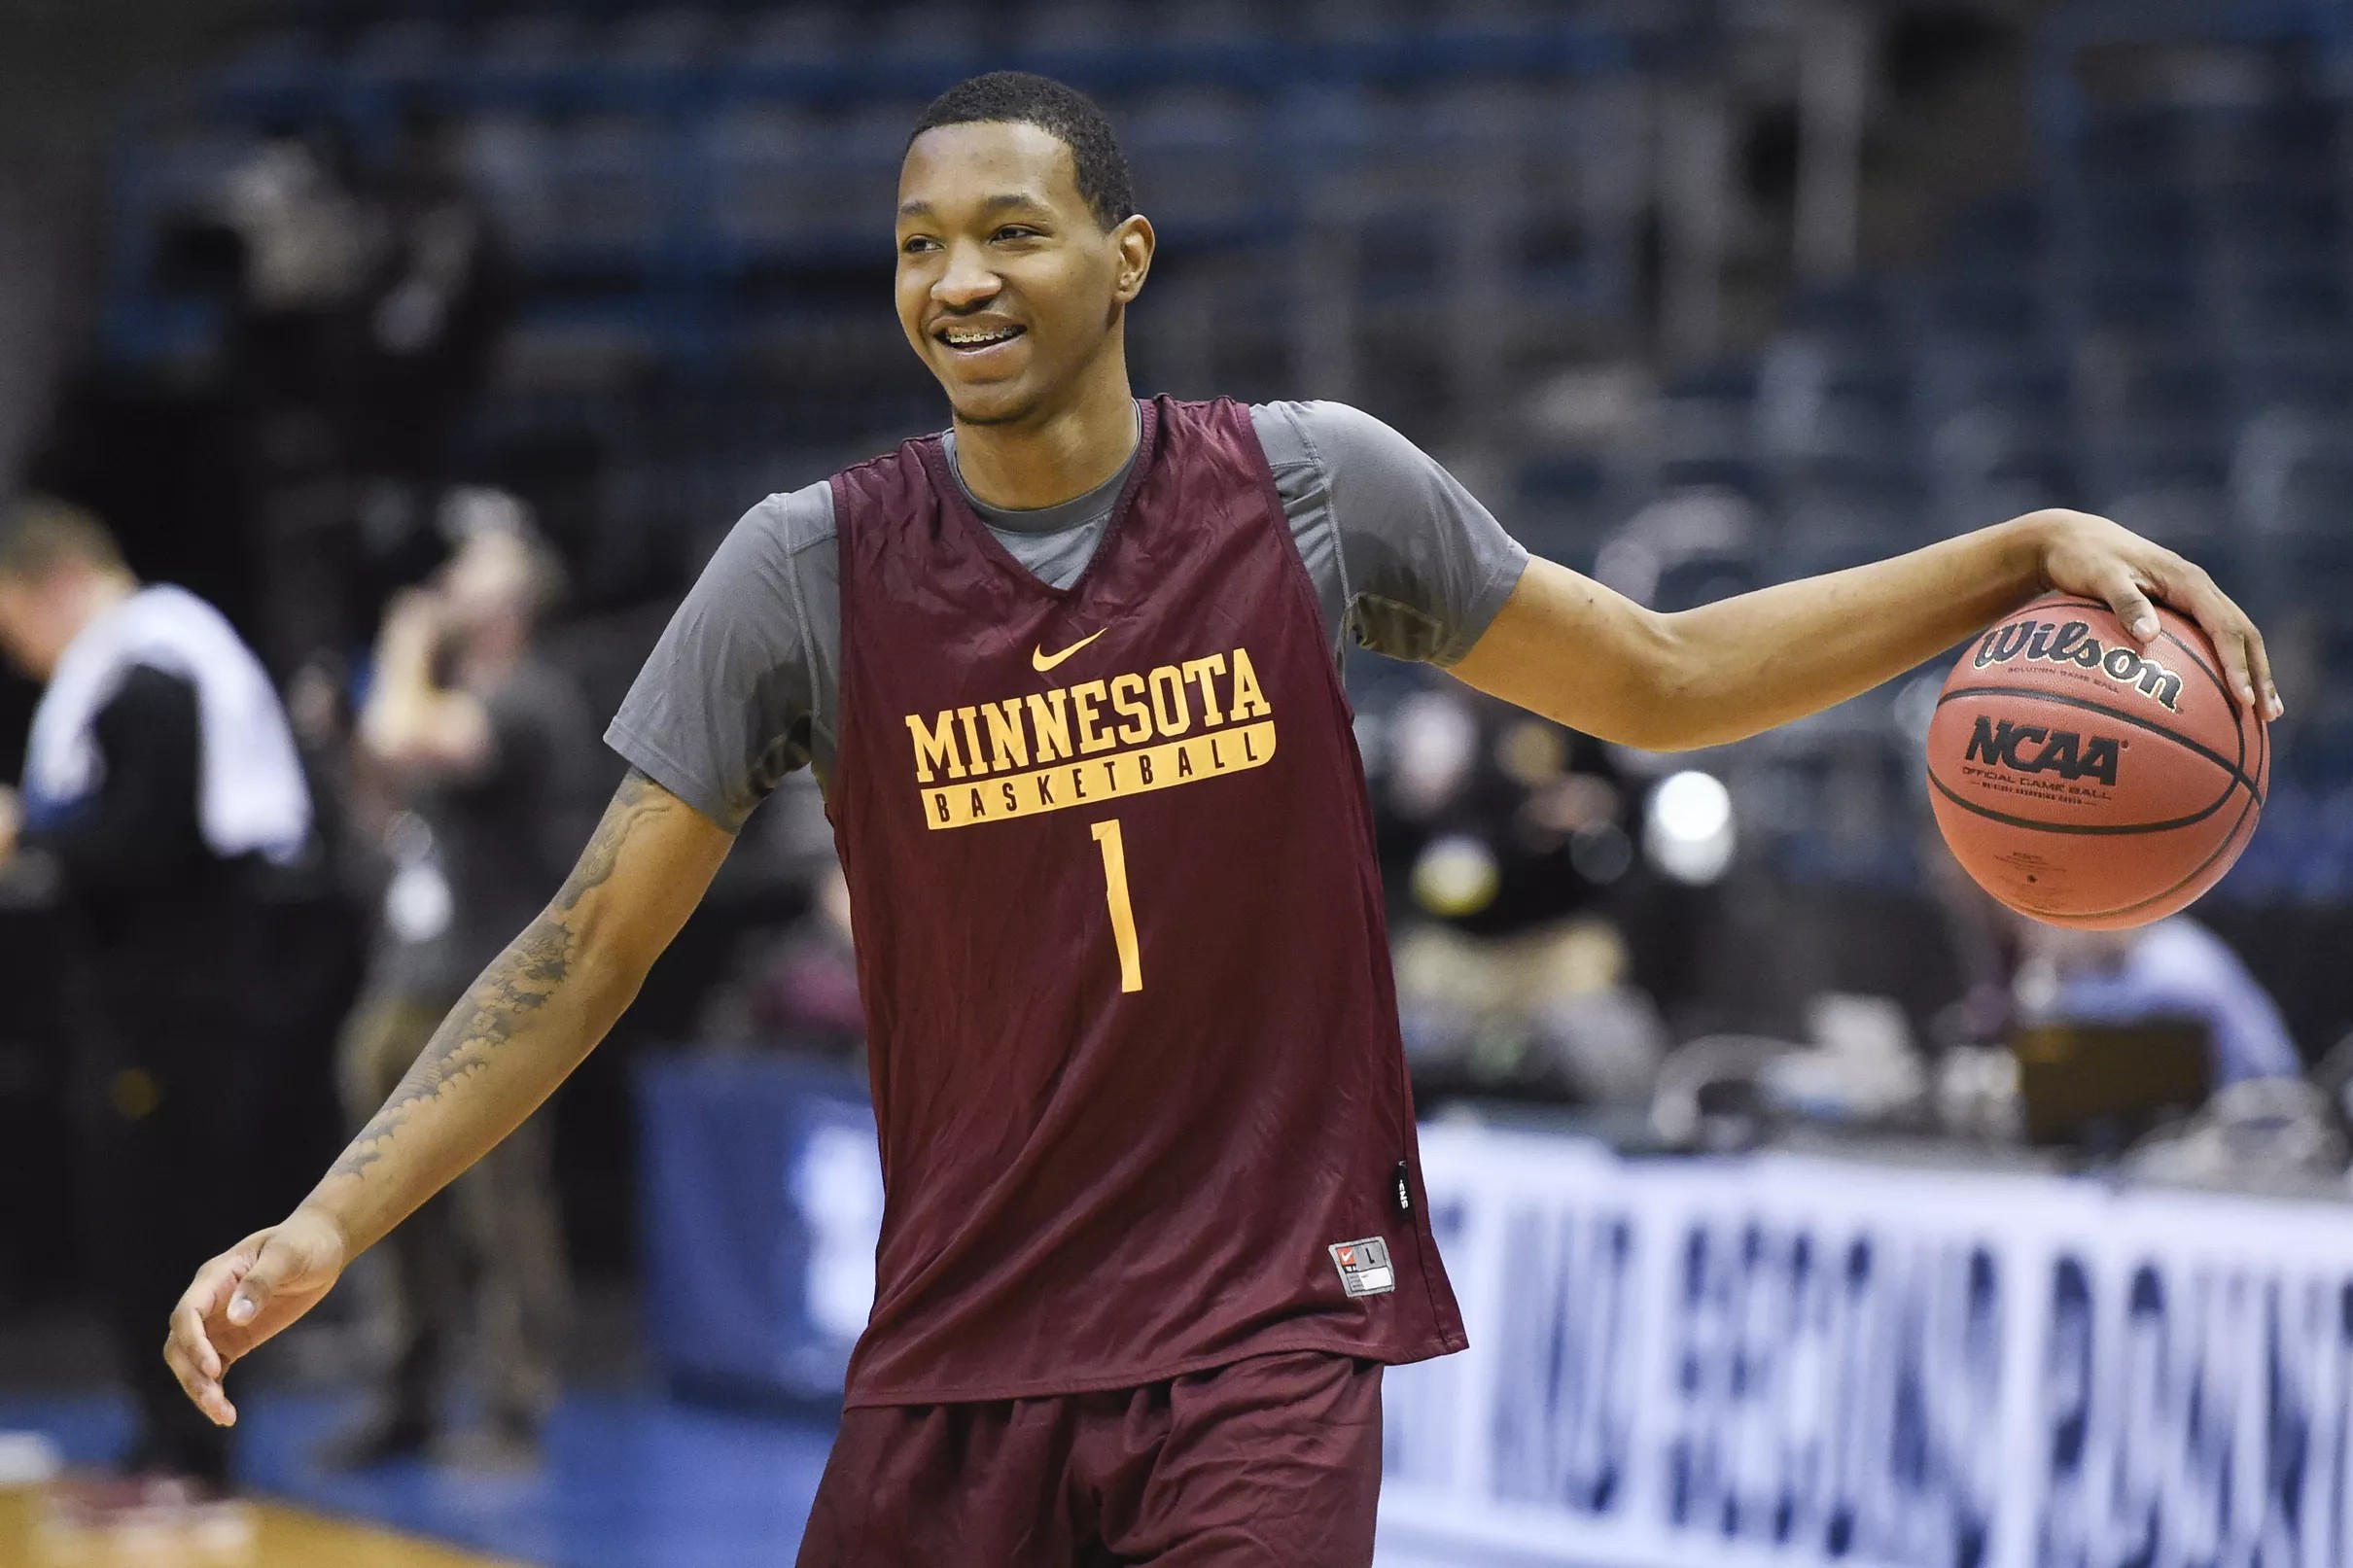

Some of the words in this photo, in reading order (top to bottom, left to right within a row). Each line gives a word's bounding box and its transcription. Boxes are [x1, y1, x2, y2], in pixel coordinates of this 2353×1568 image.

[1973, 620, 2183, 714] Wilson
[905, 647, 1272, 784] MINNESOTA
[1964, 715, 2120, 786] NCAA
[934, 731, 1258, 822] BASKETBALL
[1962, 766, 2015, 784] OFFICIAL
[2019, 778, 2065, 792] GAME
[2068, 786, 2112, 801] BALL
[1091, 819, 1142, 993] 1
